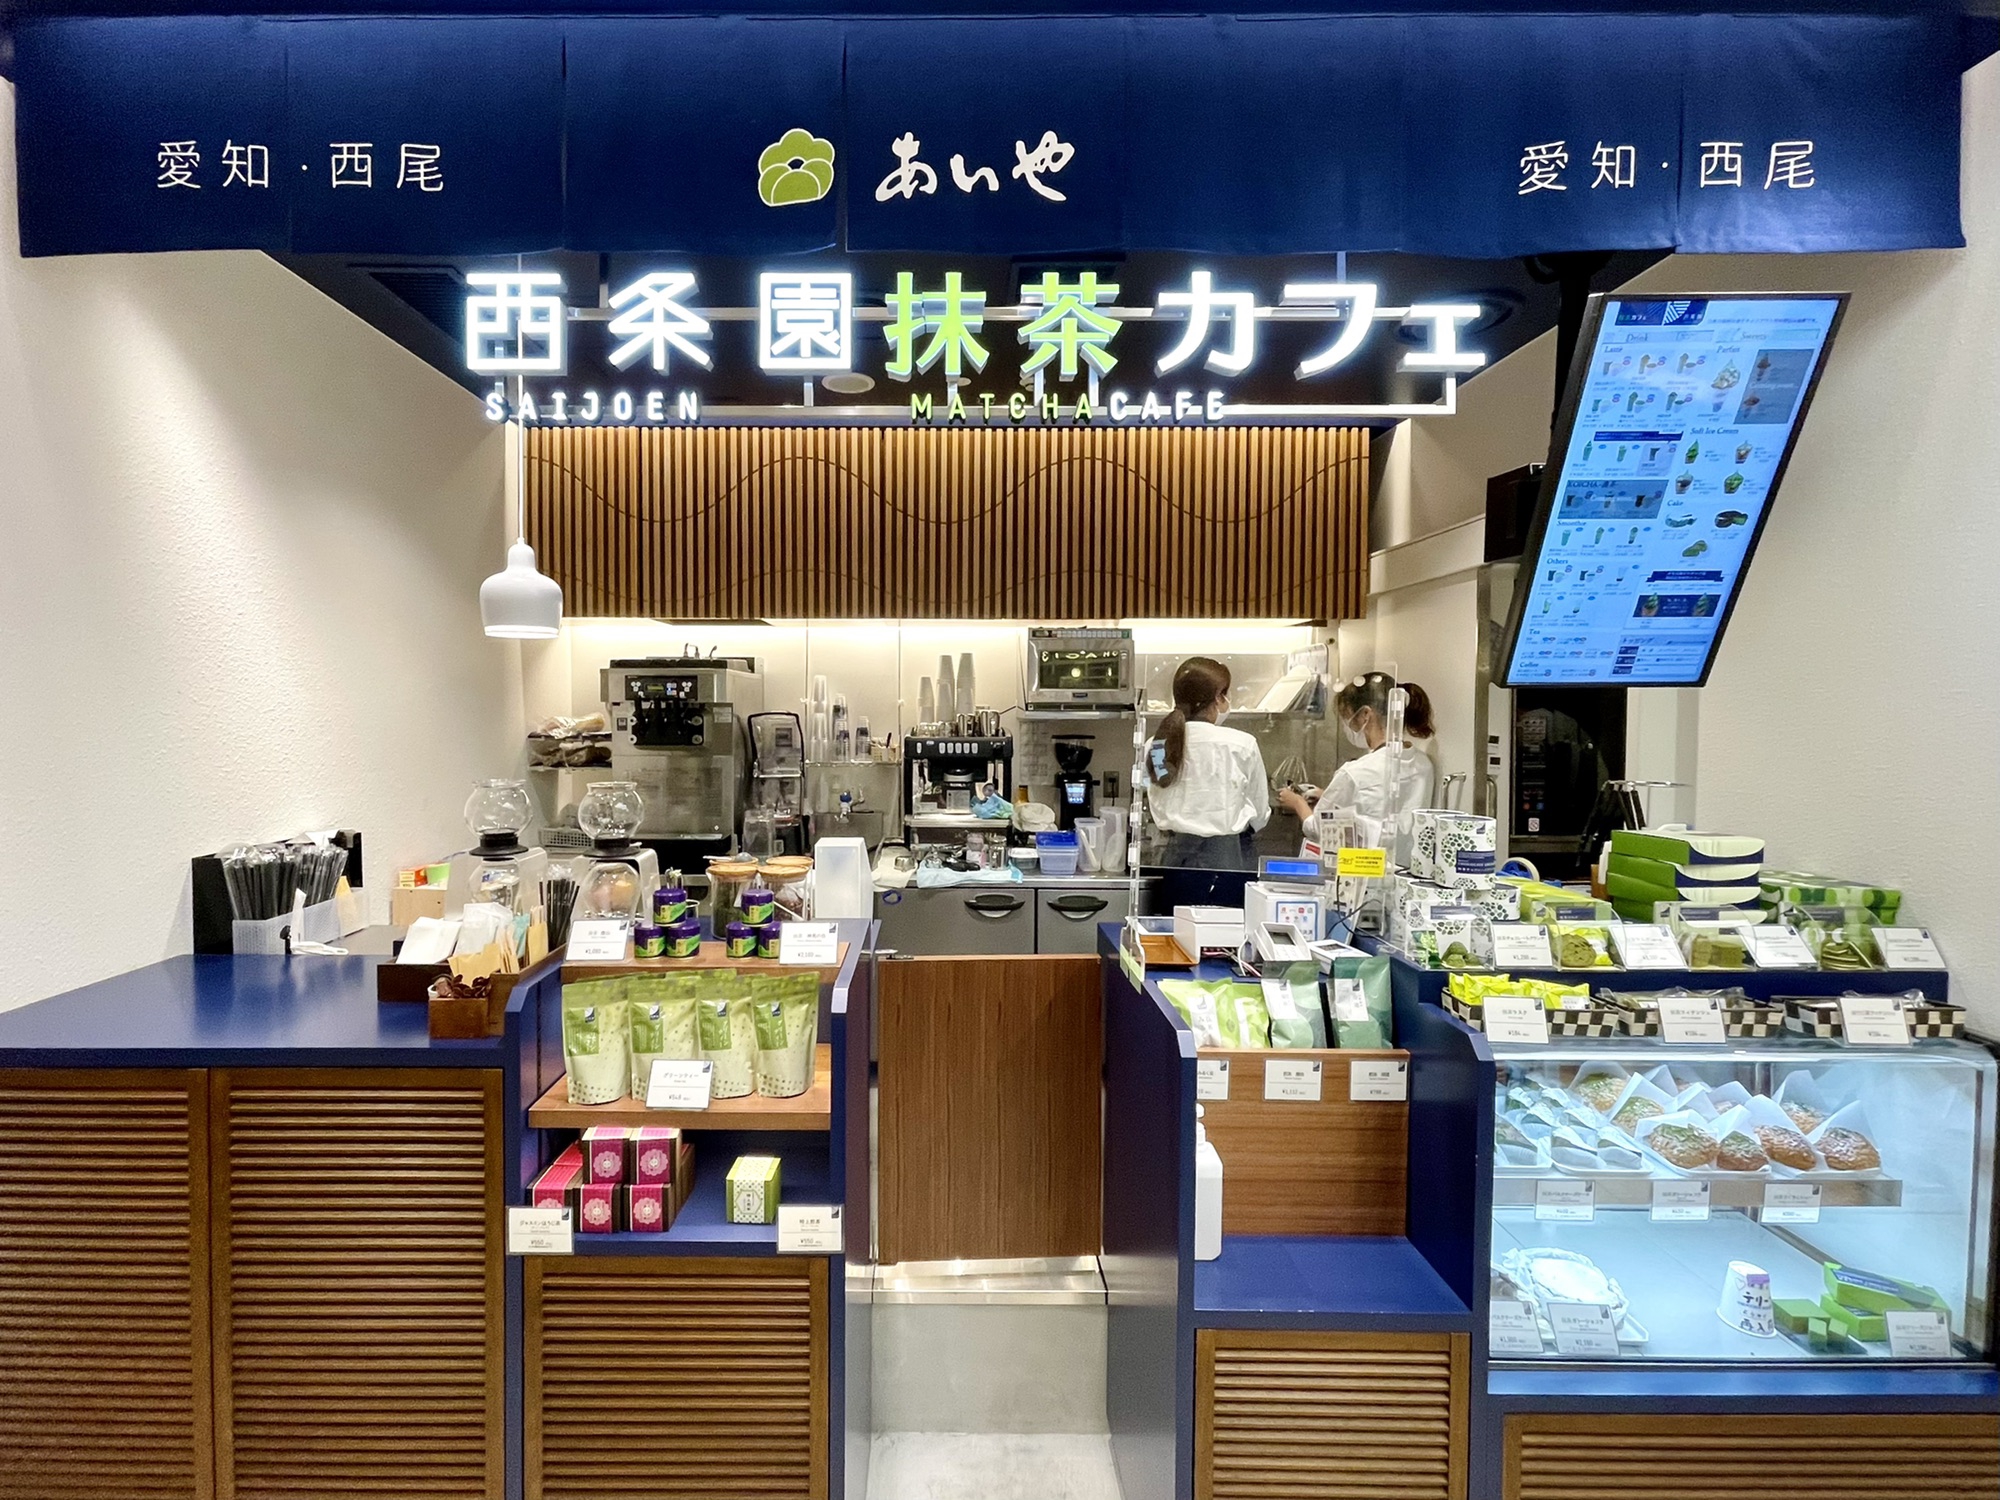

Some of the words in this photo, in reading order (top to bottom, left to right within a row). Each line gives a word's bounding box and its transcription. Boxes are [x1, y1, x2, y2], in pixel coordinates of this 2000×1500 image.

[875, 131, 1075, 201] あいや
[466, 271, 1488, 378] 西条園抹茶カフェ
[485, 391, 701, 422] SAIJOEN
